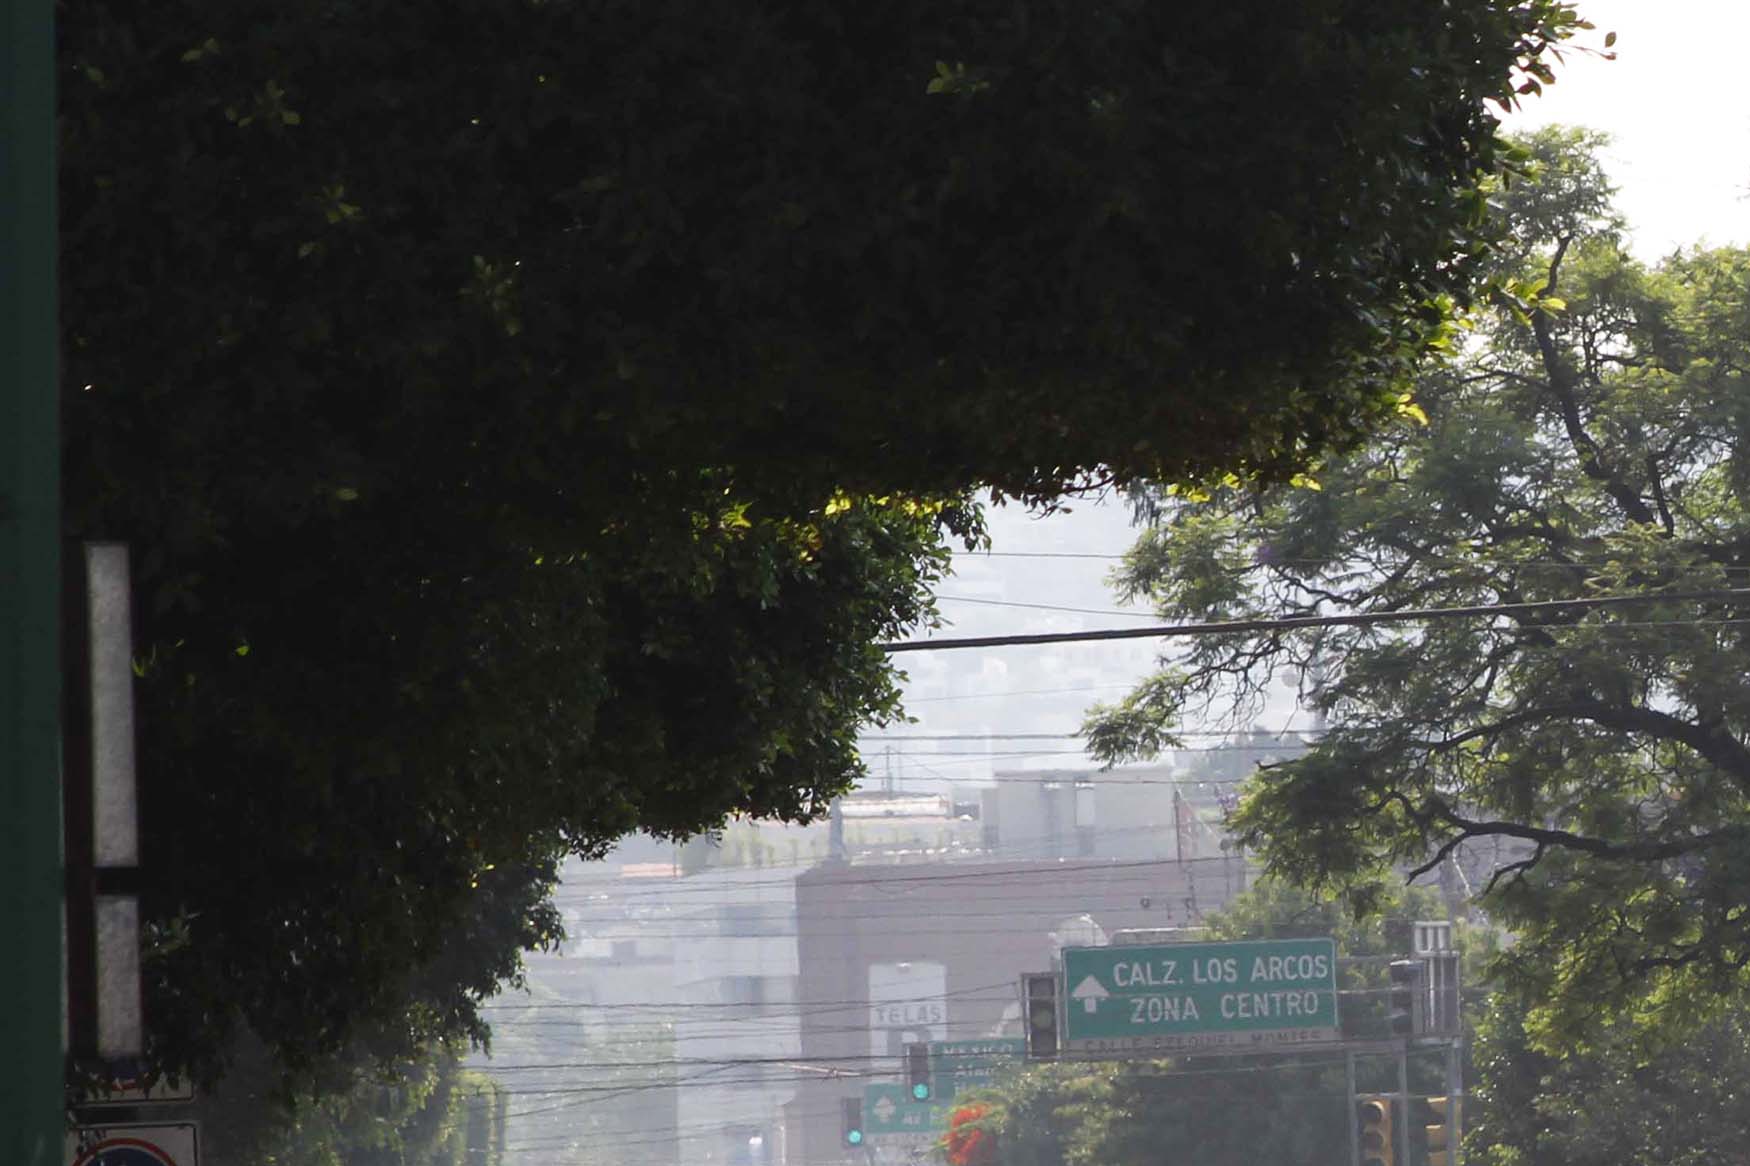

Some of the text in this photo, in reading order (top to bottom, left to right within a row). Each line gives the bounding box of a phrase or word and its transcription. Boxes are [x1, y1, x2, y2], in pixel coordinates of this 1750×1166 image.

[1112, 954, 1329, 988] CALZ. LOS ARCOS
[1129, 990, 1319, 1024] ZONA CENTRO
